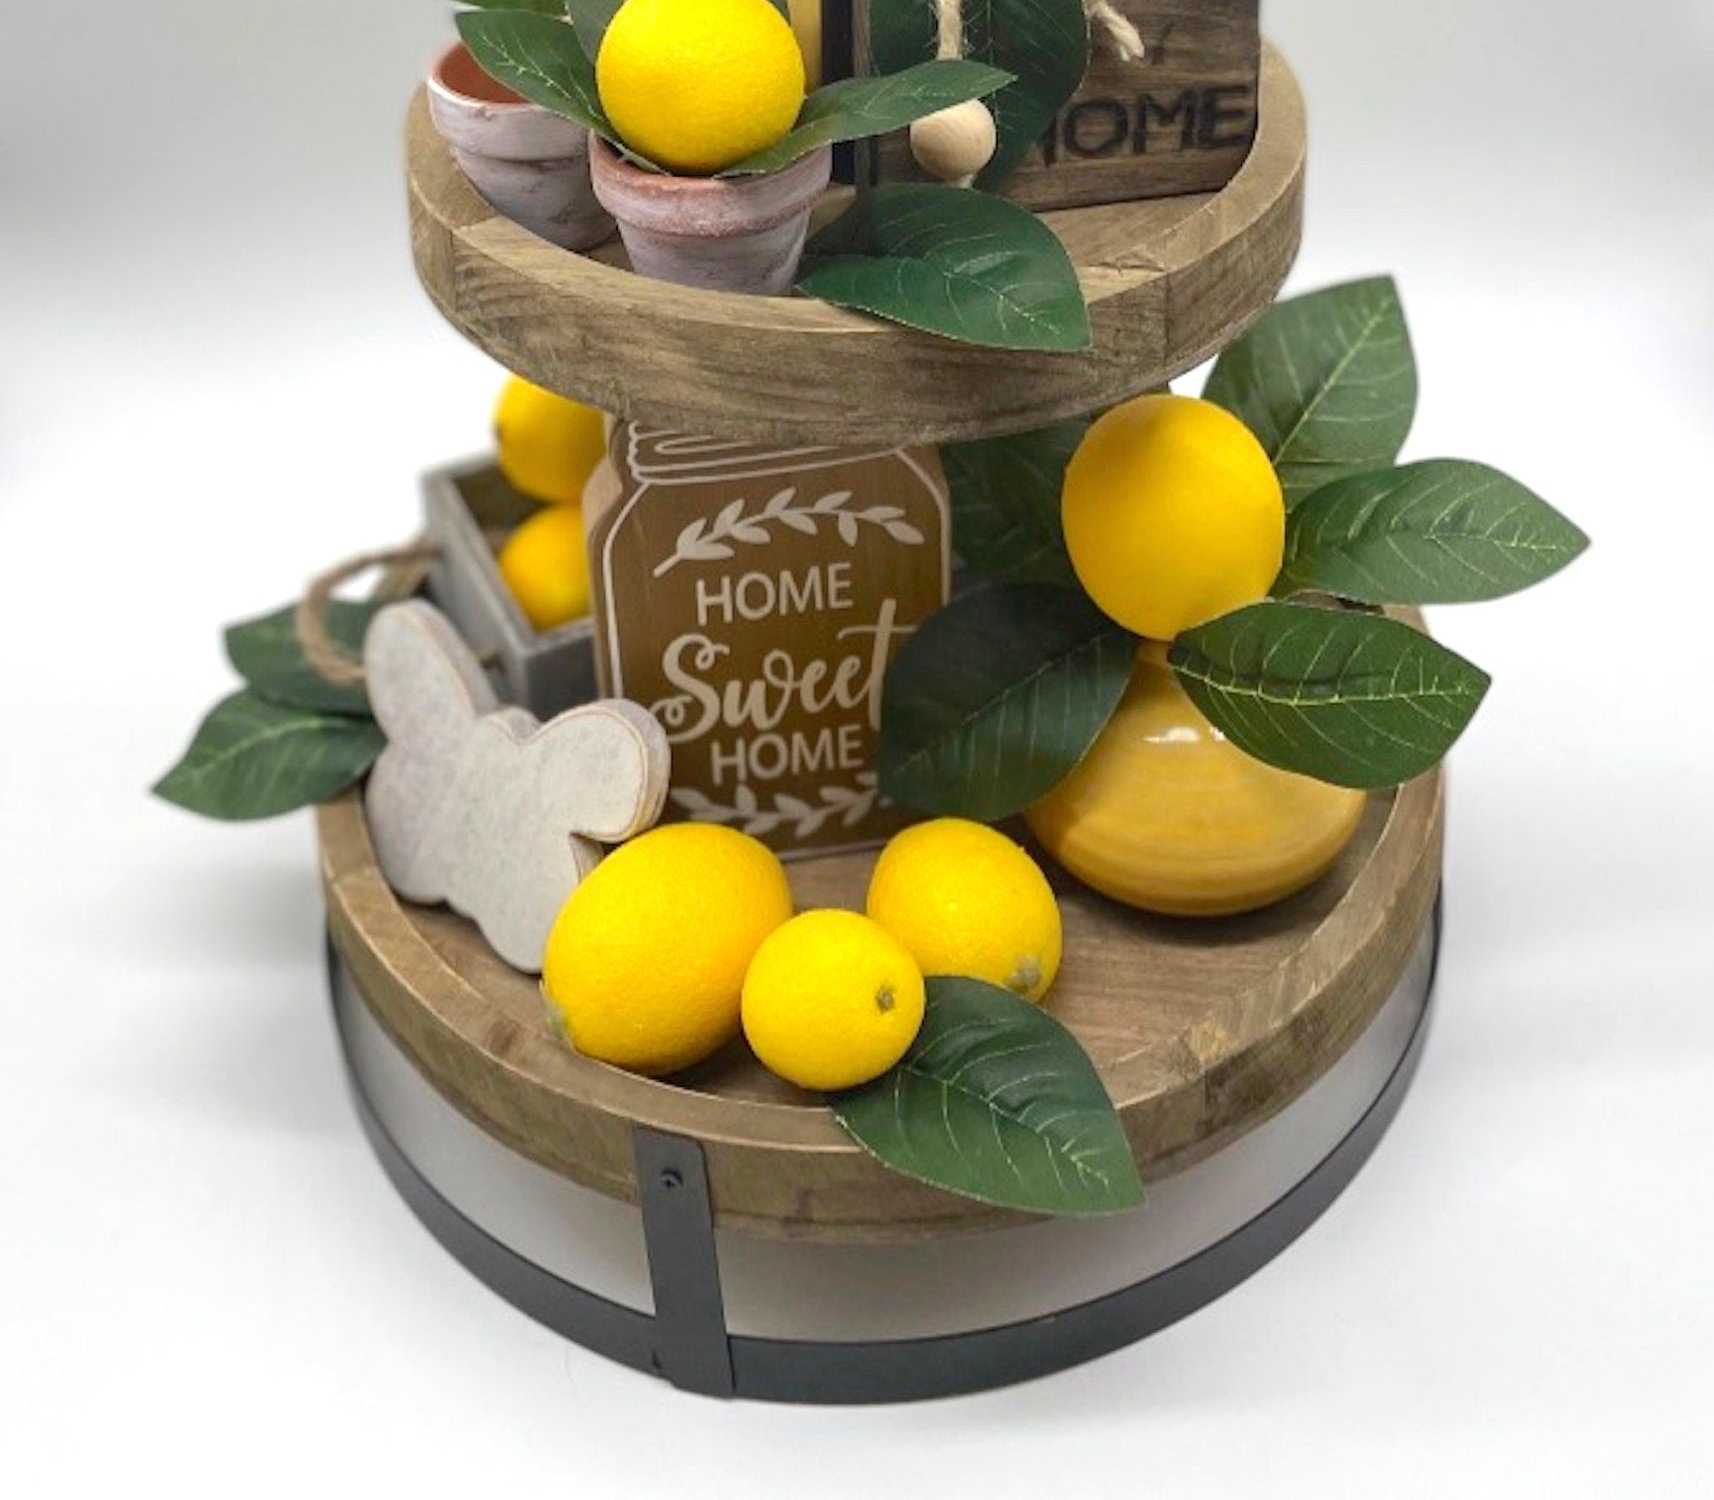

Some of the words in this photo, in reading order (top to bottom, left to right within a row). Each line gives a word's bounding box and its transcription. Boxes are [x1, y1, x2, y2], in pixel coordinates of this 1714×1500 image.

[695, 562, 853, 625] HOME
[648, 598, 917, 743] Sweet
[711, 723, 863, 786] HOME
